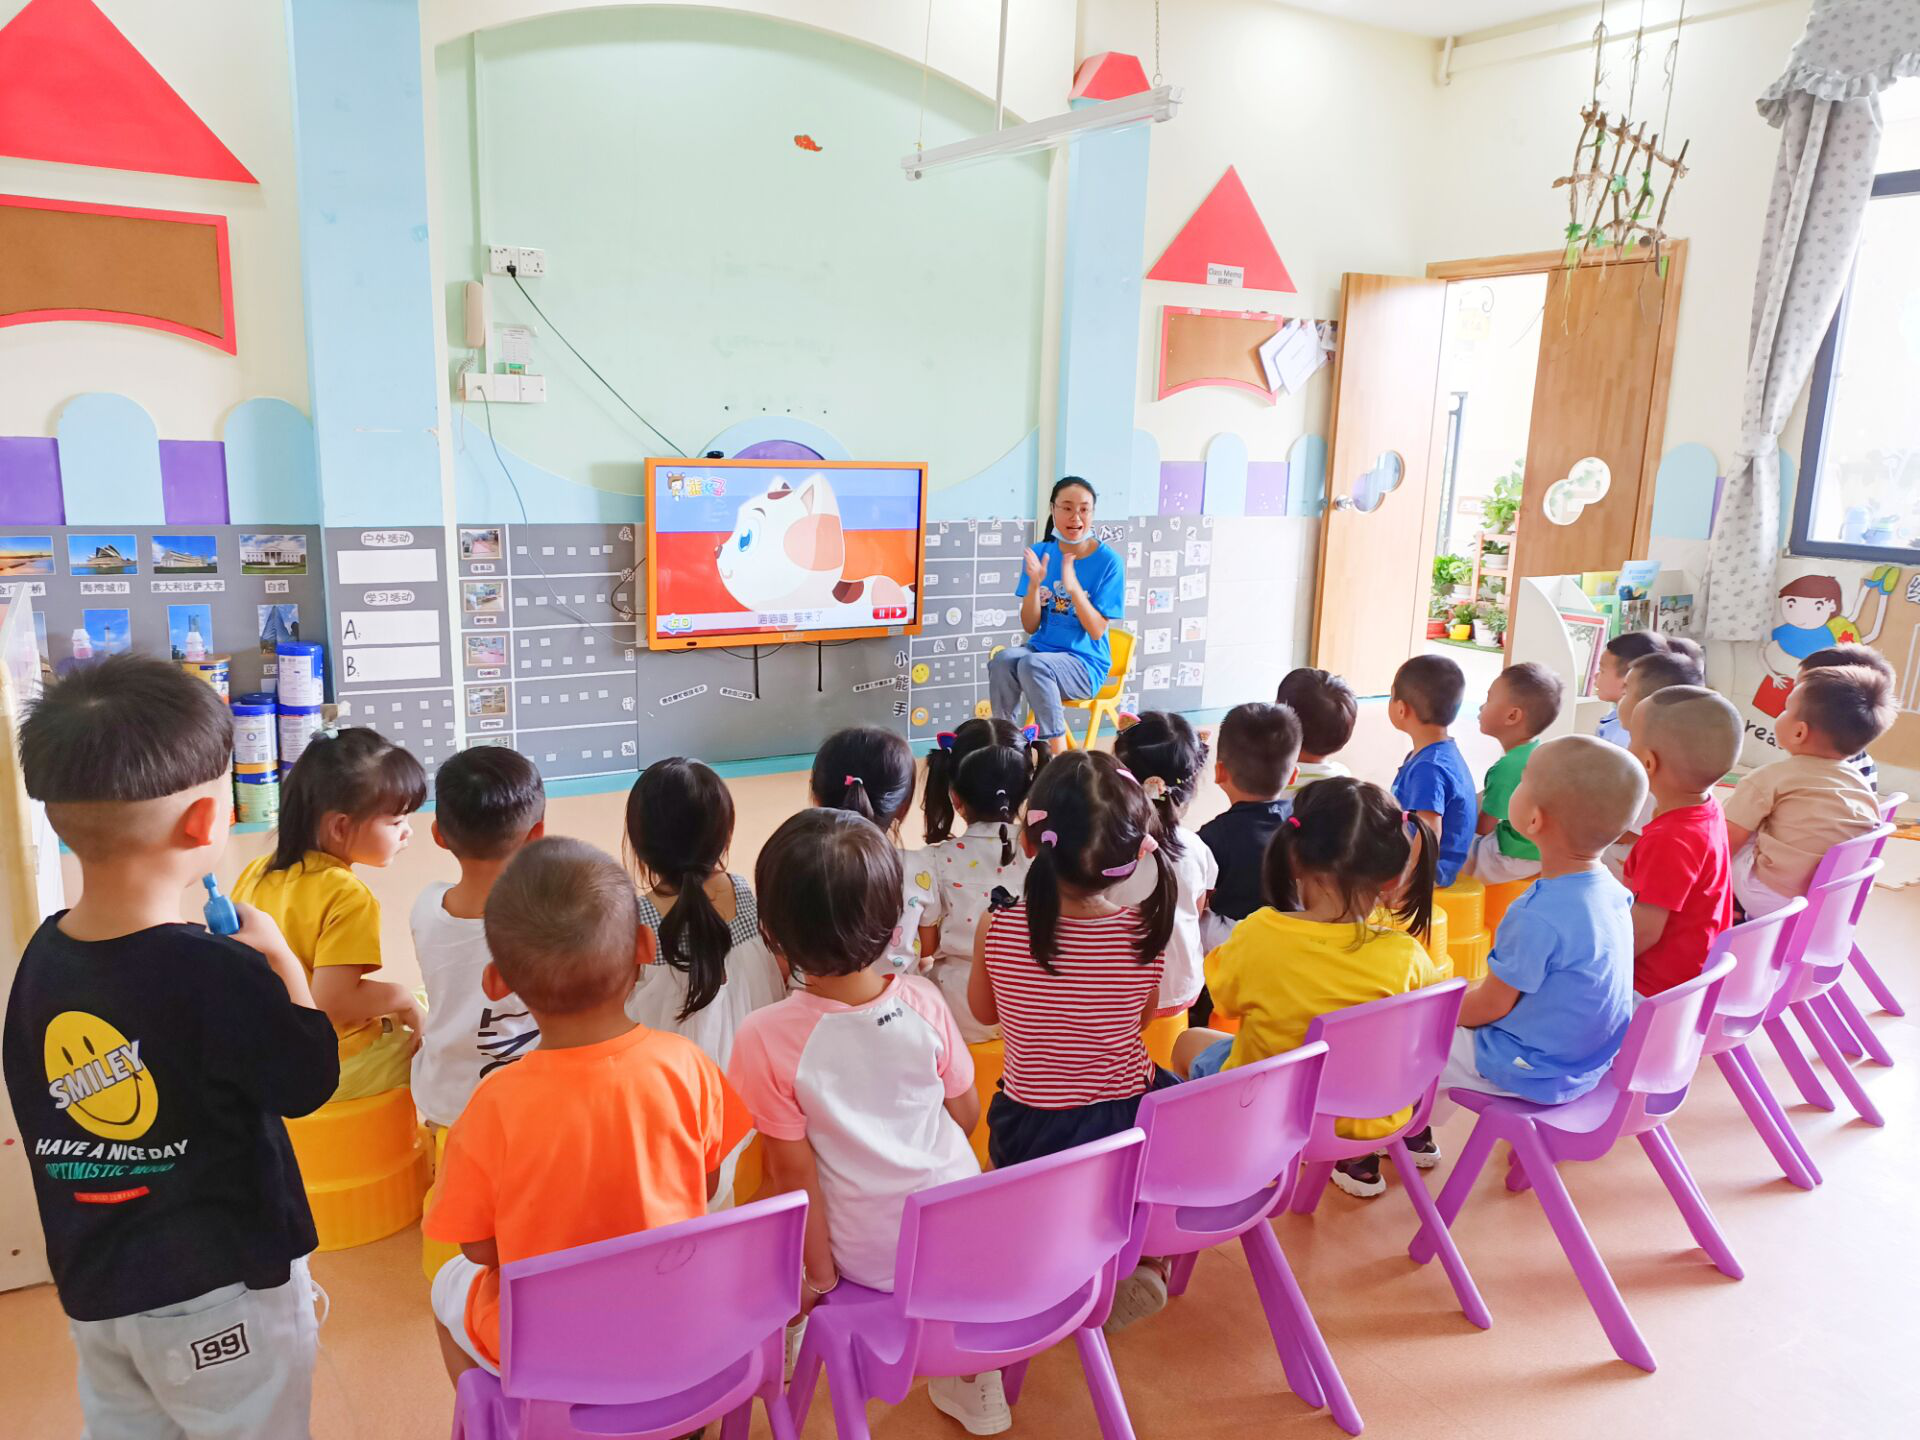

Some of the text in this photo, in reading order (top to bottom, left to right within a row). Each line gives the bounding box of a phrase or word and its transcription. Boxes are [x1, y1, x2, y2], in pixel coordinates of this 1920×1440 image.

[363, 533, 411, 544] 户外活动
[1090, 526, 1125, 542] 公约
[152, 581, 223, 592] 意大利比萨大学
[267, 582, 286, 592] 白宫
[365, 593, 413, 604] 学习活动
[893, 651, 910, 718] 小能手
[1744, 719, 1785, 750] rea
[48, 1039, 144, 1110] SMILEY
[35, 1138, 189, 1161] HAVE A NICE DAY
[45, 1162, 130, 1180] OPTIMISTIC
[202, 1333, 241, 1361] 99
